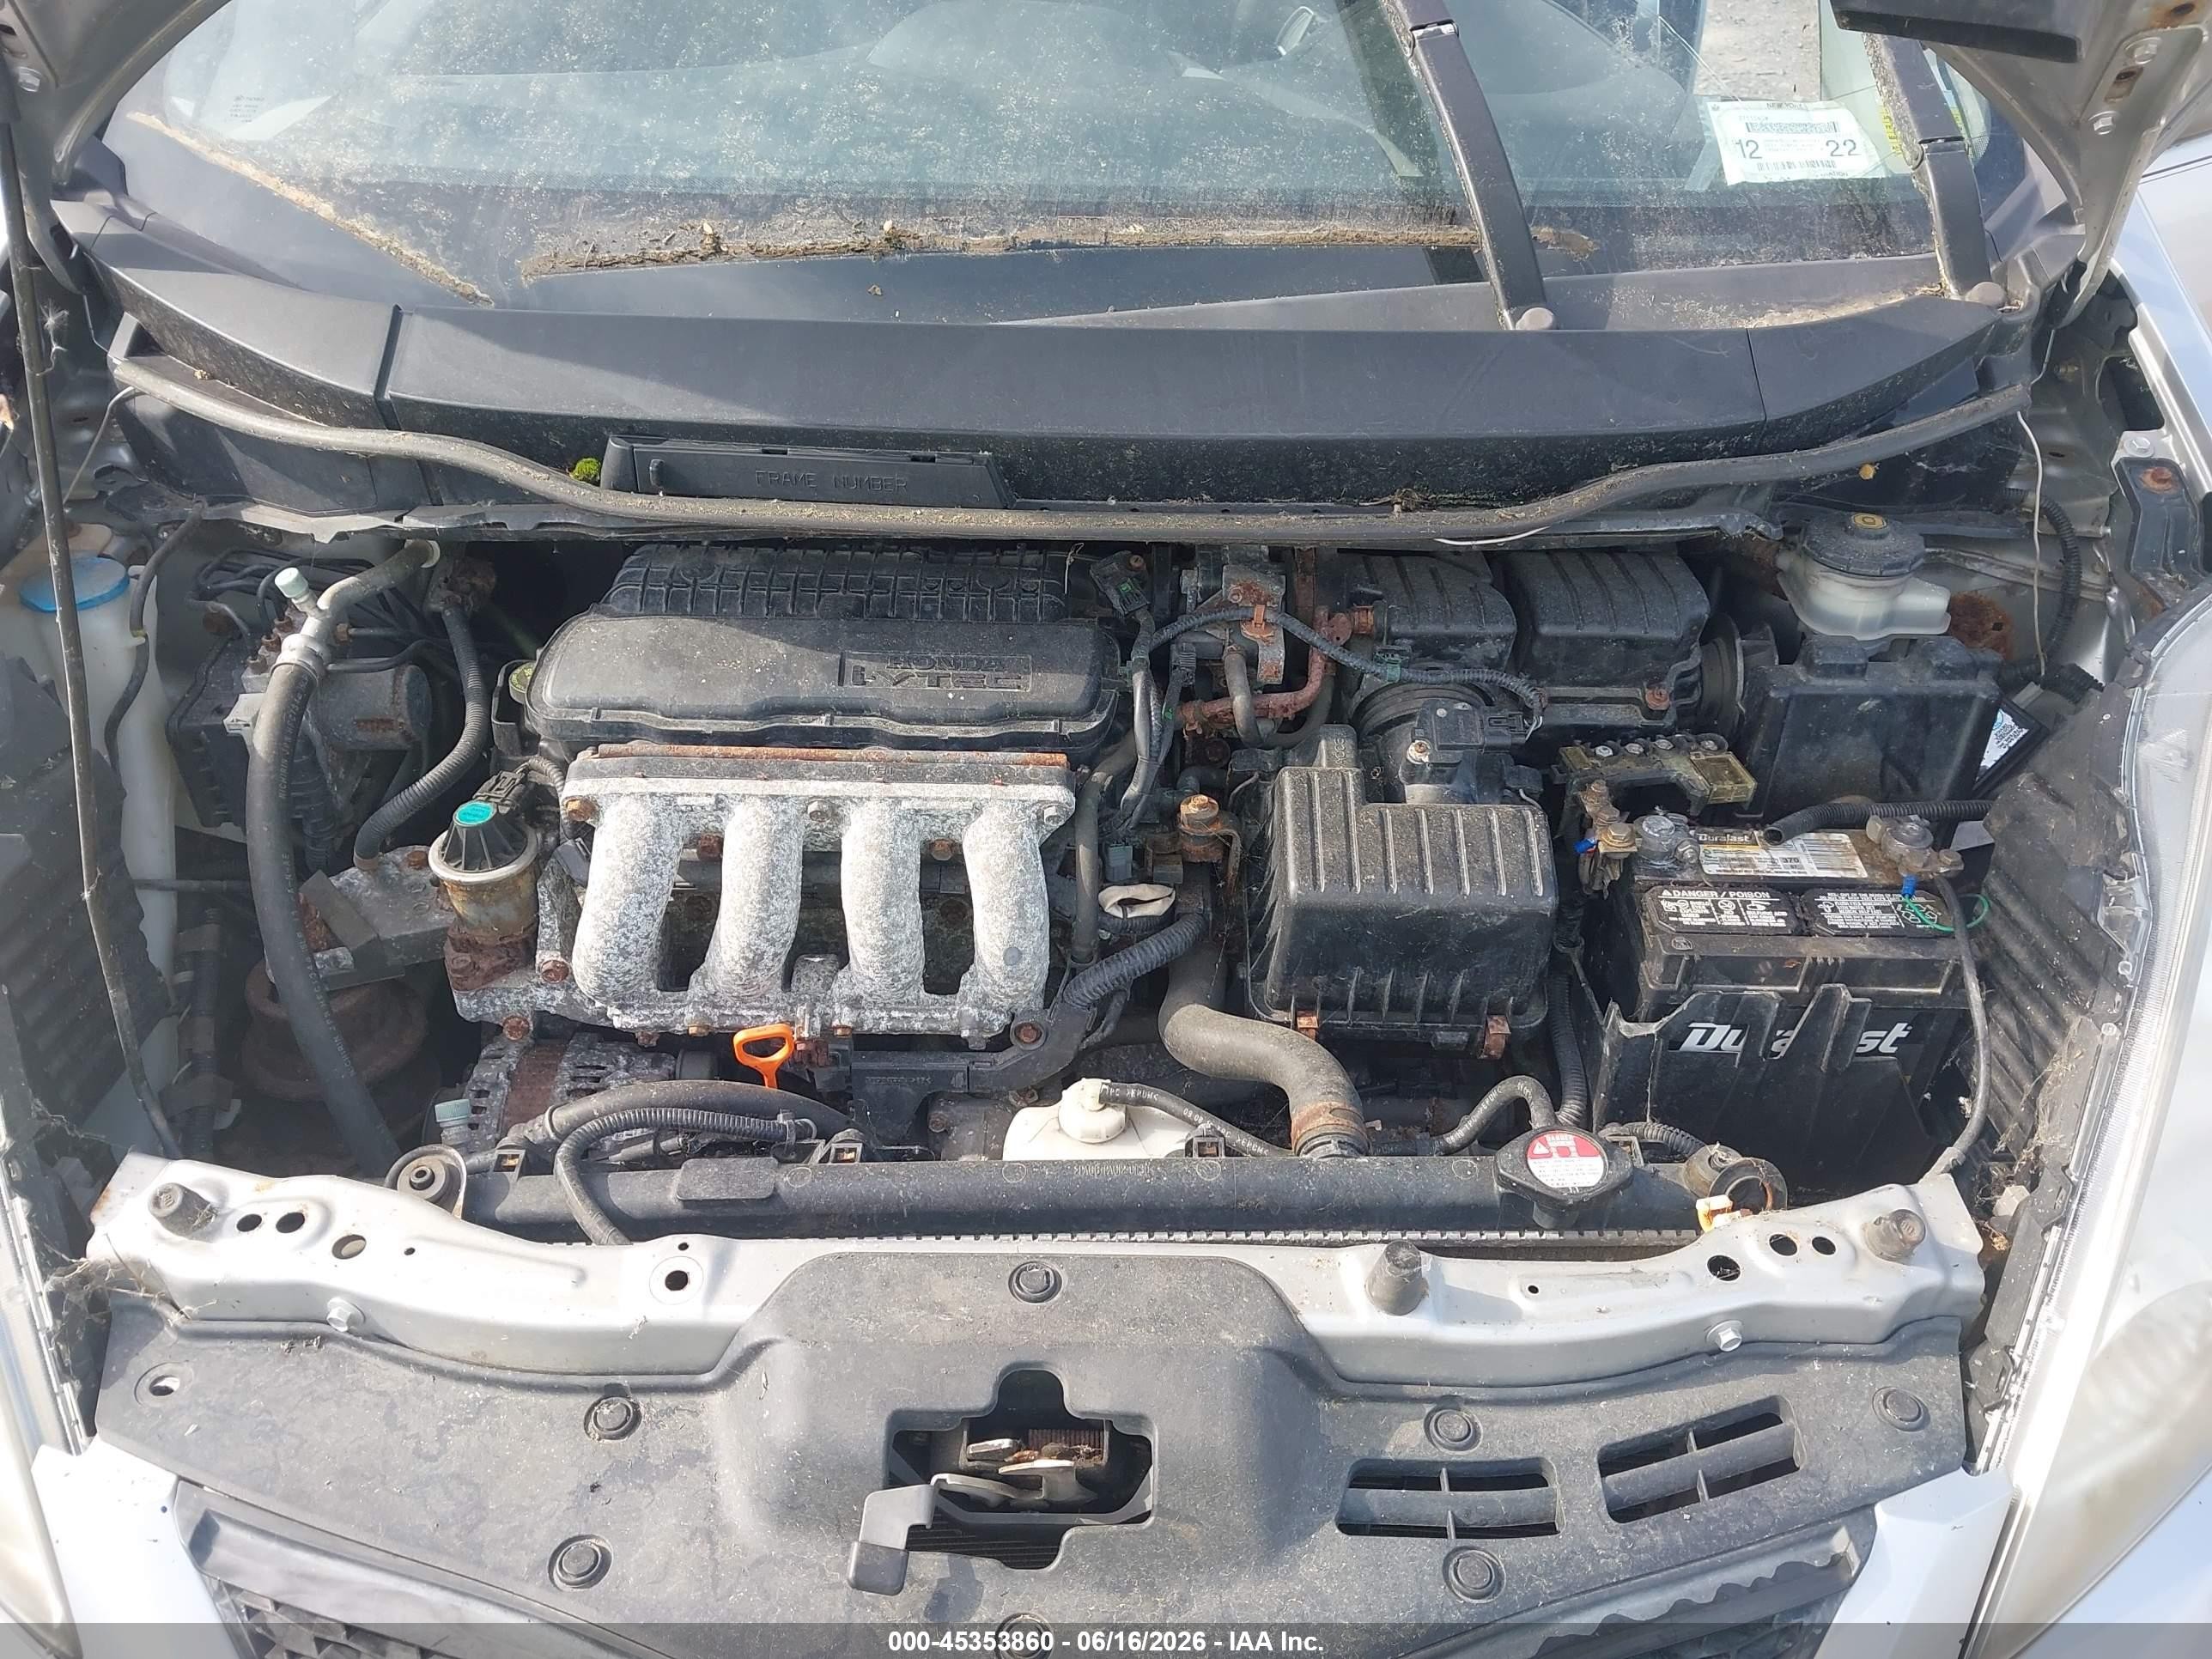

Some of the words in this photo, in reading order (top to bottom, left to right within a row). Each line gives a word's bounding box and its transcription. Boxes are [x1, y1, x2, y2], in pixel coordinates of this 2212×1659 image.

[1735, 140, 1763, 160] 12
[1826, 139, 1863, 158] 22
[755, 470, 817, 488] FRAME
[833, 473, 908, 492] NUMBER
[886, 654, 1005, 672] HONDA
[1673, 890, 1718, 898] DANGER
